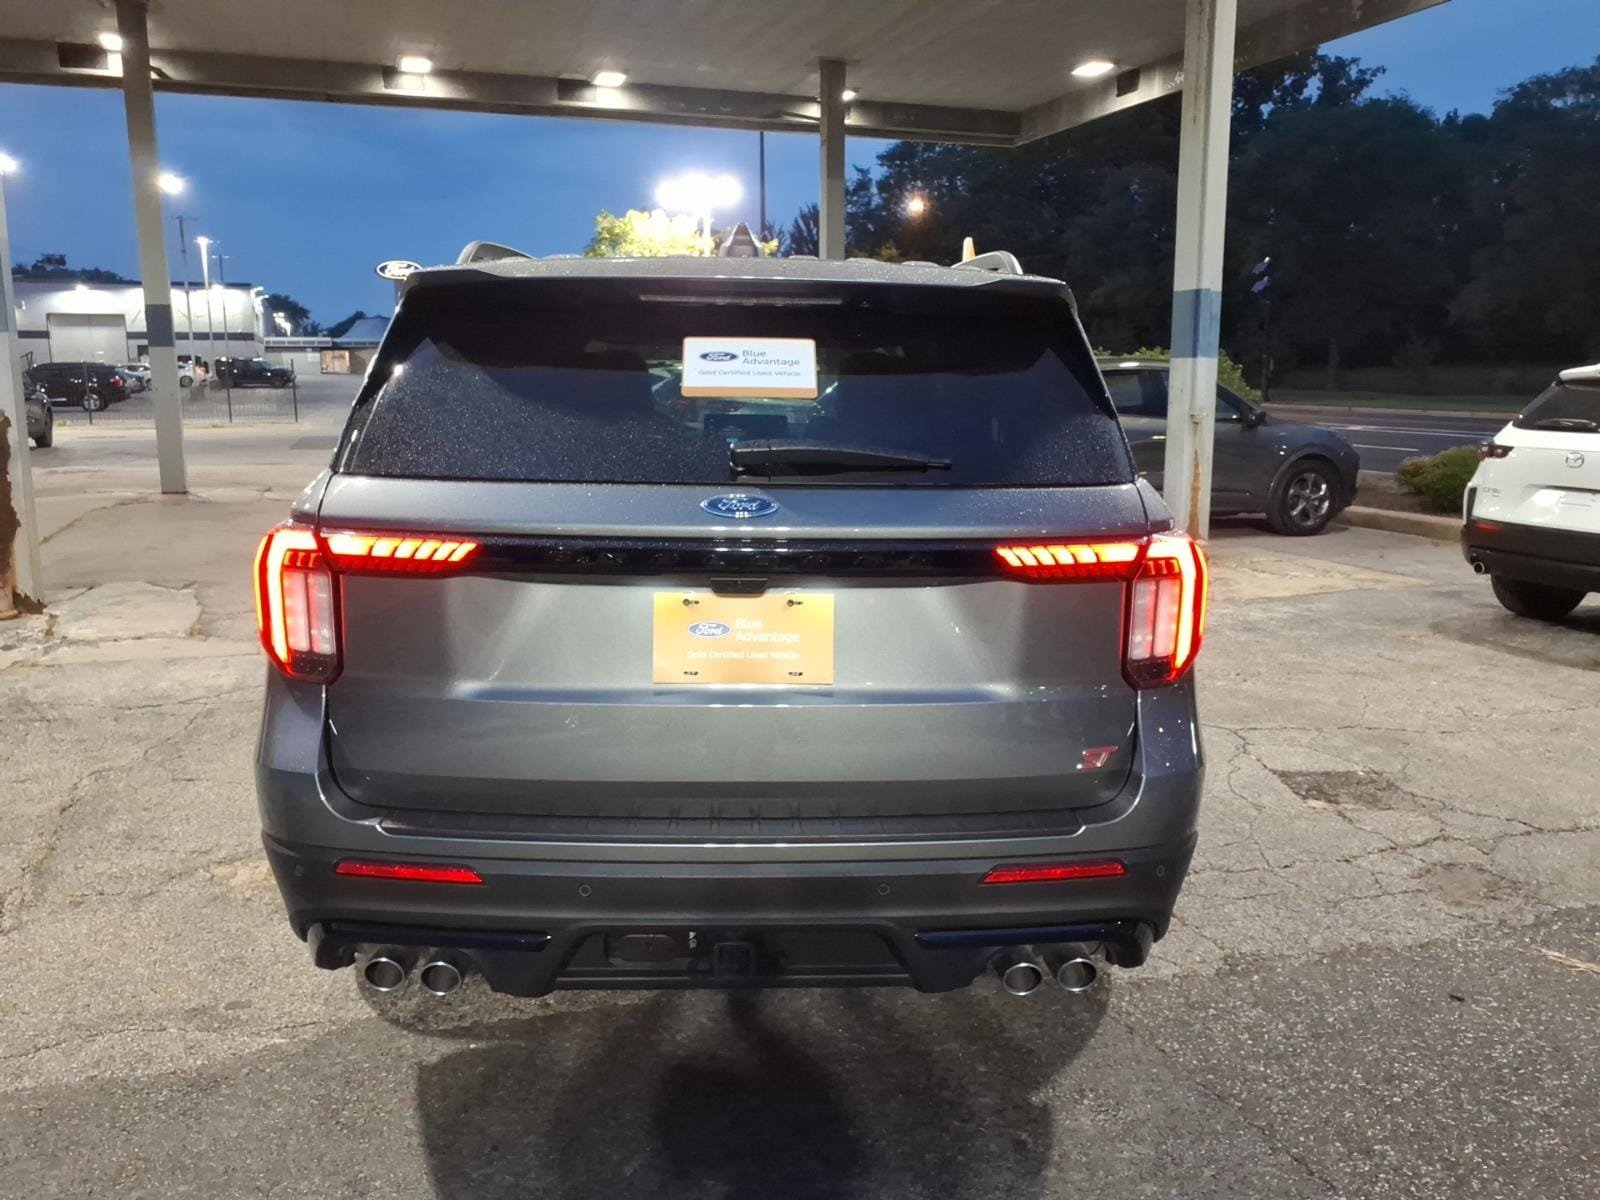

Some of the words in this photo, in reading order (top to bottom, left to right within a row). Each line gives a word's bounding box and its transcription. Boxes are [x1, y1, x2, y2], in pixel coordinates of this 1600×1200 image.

[706, 353, 733, 361] Ford
[742, 358, 800, 366] Advantage
[718, 498, 760, 511] Ford
[695, 623, 723, 636] Ford
[736, 631, 800, 643] Advantage
